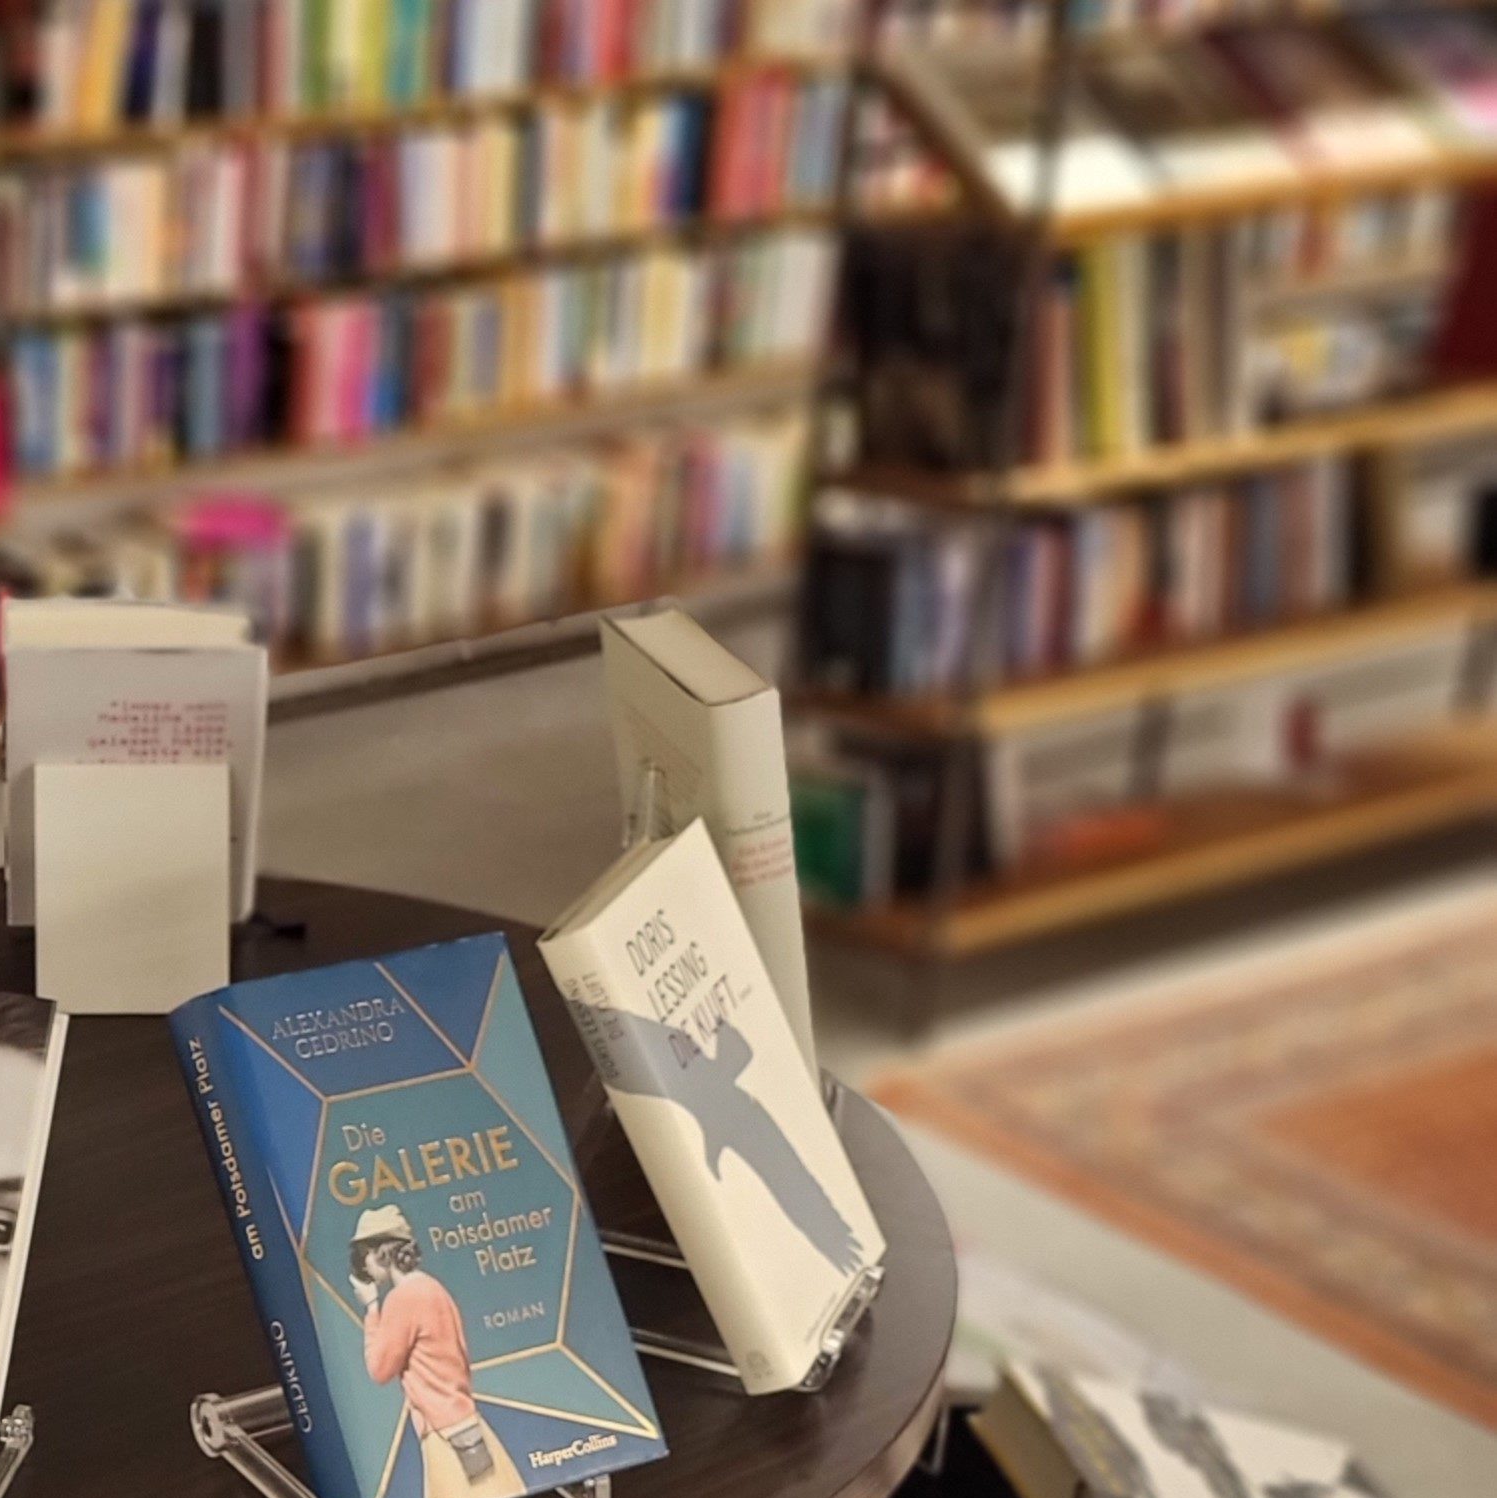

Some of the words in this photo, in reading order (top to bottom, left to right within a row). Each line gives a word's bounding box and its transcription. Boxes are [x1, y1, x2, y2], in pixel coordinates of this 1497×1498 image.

[626, 909, 675, 977] DORIS
[647, 941, 708, 1024] LESSING
[271, 997, 406, 1041] ALEXANDRA
[294, 1020, 395, 1060] CEDRINO
[668, 1018, 701, 1070] DIE
[690, 973, 738, 1046] KLUFT
[188, 1035, 215, 1095] Platz
[206, 1099, 252, 1219] Potsdamer
[341, 1122, 387, 1152] Die
[327, 1124, 520, 1207] GALERIE
[448, 1190, 487, 1213] am
[244, 1223, 265, 1261] am
[427, 1207, 552, 1252] Potsdamer
[474, 1245, 538, 1277] Platz
[482, 1301, 546, 1330] ROMAN
[269, 1320, 312, 1434] CEDRINO
[528, 1432, 618, 1469] HarperCollins
